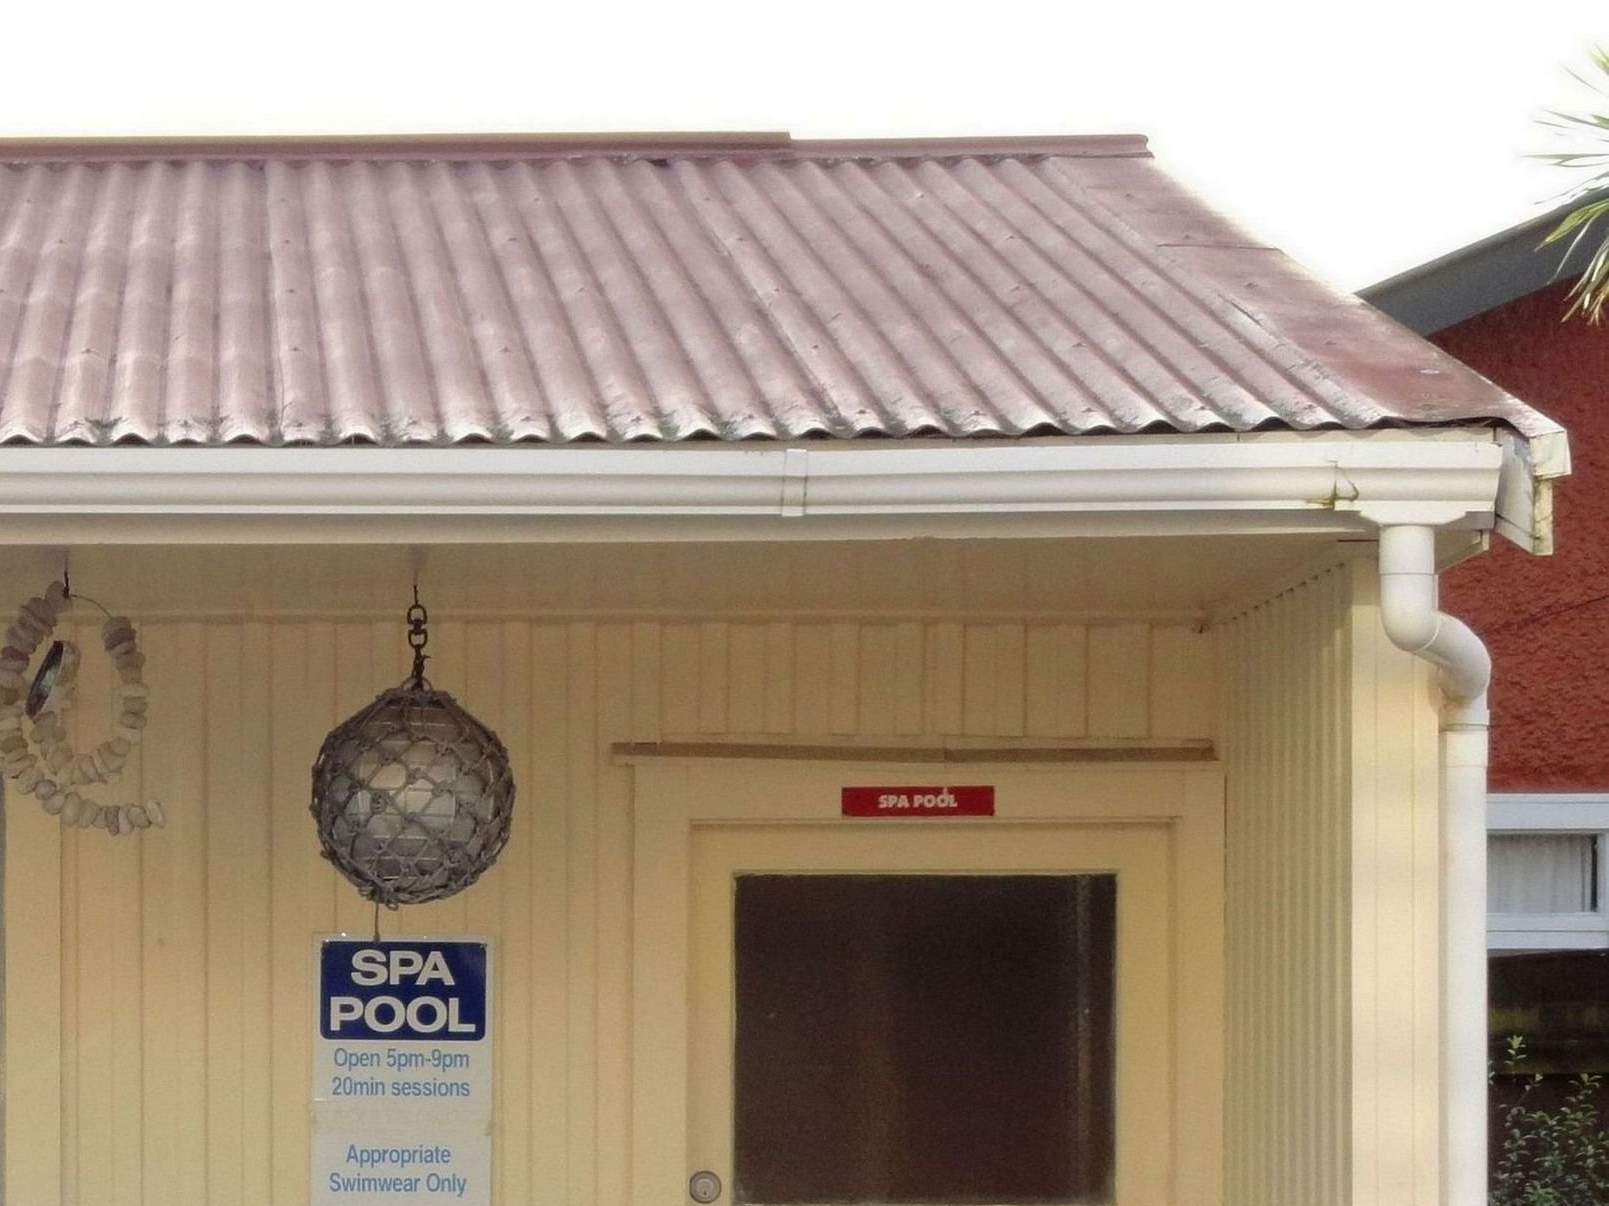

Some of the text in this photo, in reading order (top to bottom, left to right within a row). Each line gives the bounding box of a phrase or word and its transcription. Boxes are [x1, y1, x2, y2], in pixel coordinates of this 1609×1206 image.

[878, 795, 958, 808] SPA POOL
[351, 950, 456, 986] SPA
[330, 996, 477, 1033] POOL
[334, 1048, 469, 1072] Open 5pm-9pm
[332, 1077, 470, 1097] 20min sessions
[346, 1144, 451, 1168] Appropriate
[329, 1173, 467, 1197] Swimwear Only
